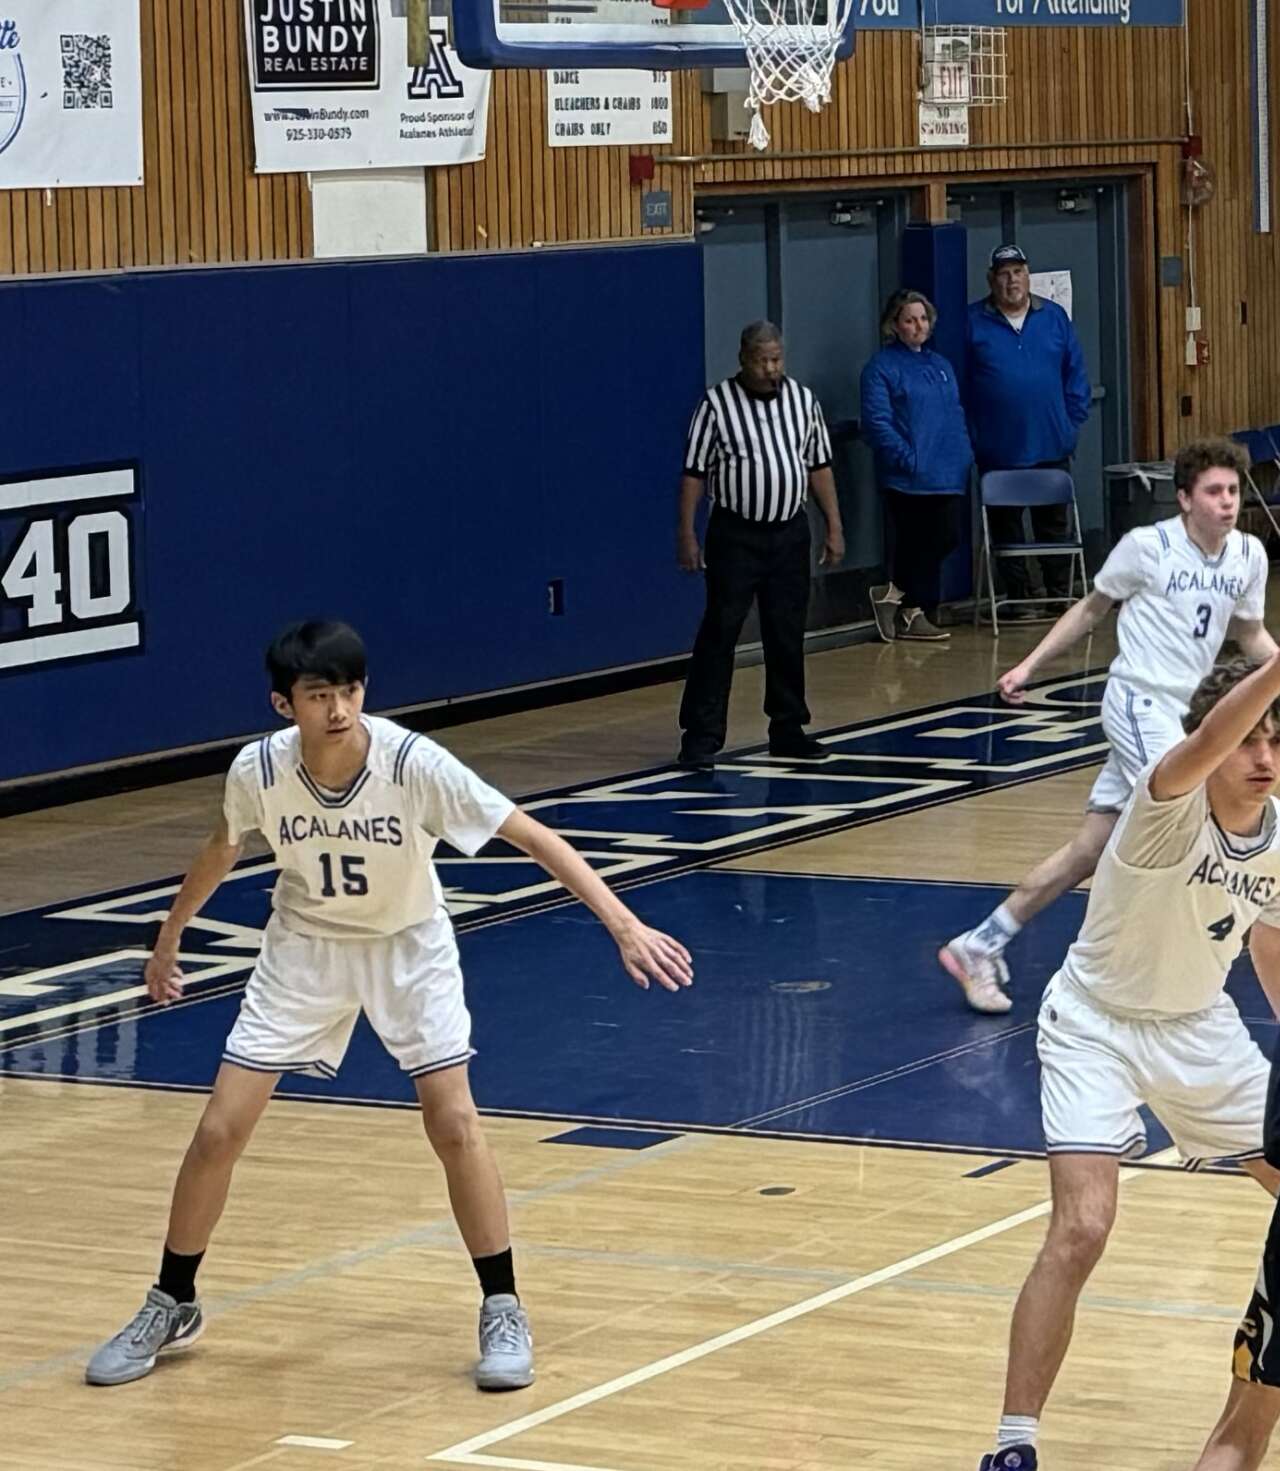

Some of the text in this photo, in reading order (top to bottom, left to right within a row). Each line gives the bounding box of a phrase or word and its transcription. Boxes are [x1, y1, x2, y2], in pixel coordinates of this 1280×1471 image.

[260, 0, 366, 22] JUSTIN
[262, 25, 367, 53] BUNDY
[264, 56, 368, 72] REAL ESTATE
[554, 97, 600, 111] BLEACHERS
[612, 97, 641, 110] CHAIRS
[555, 122, 584, 136] CHAIRS
[920, 121, 967, 135] SMOKING
[1, 511, 130, 627] 40
[1193, 603, 1211, 639] 3
[279, 815, 402, 846] ACALANES
[319, 853, 368, 897] 15
[1207, 913, 1235, 941] 4
